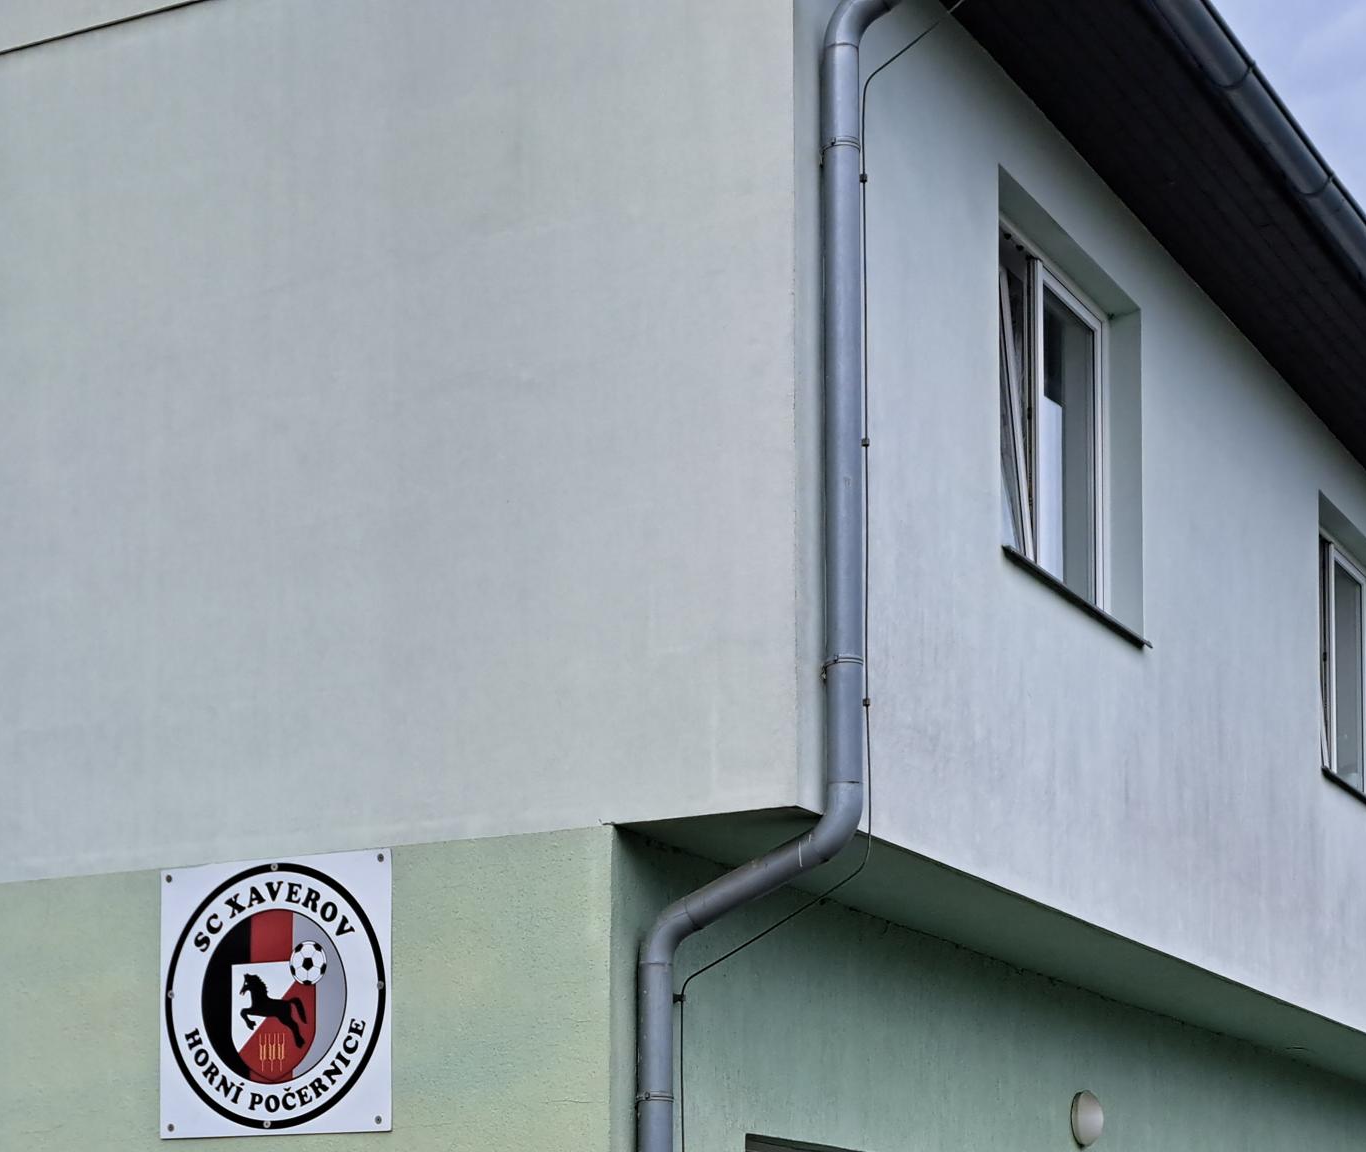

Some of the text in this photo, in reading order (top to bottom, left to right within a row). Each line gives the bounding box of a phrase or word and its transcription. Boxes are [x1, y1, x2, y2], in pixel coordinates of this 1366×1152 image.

[193, 881, 355, 953] SC XAVEROV
[184, 1018, 366, 1113] HORNÍ POČERNICE
